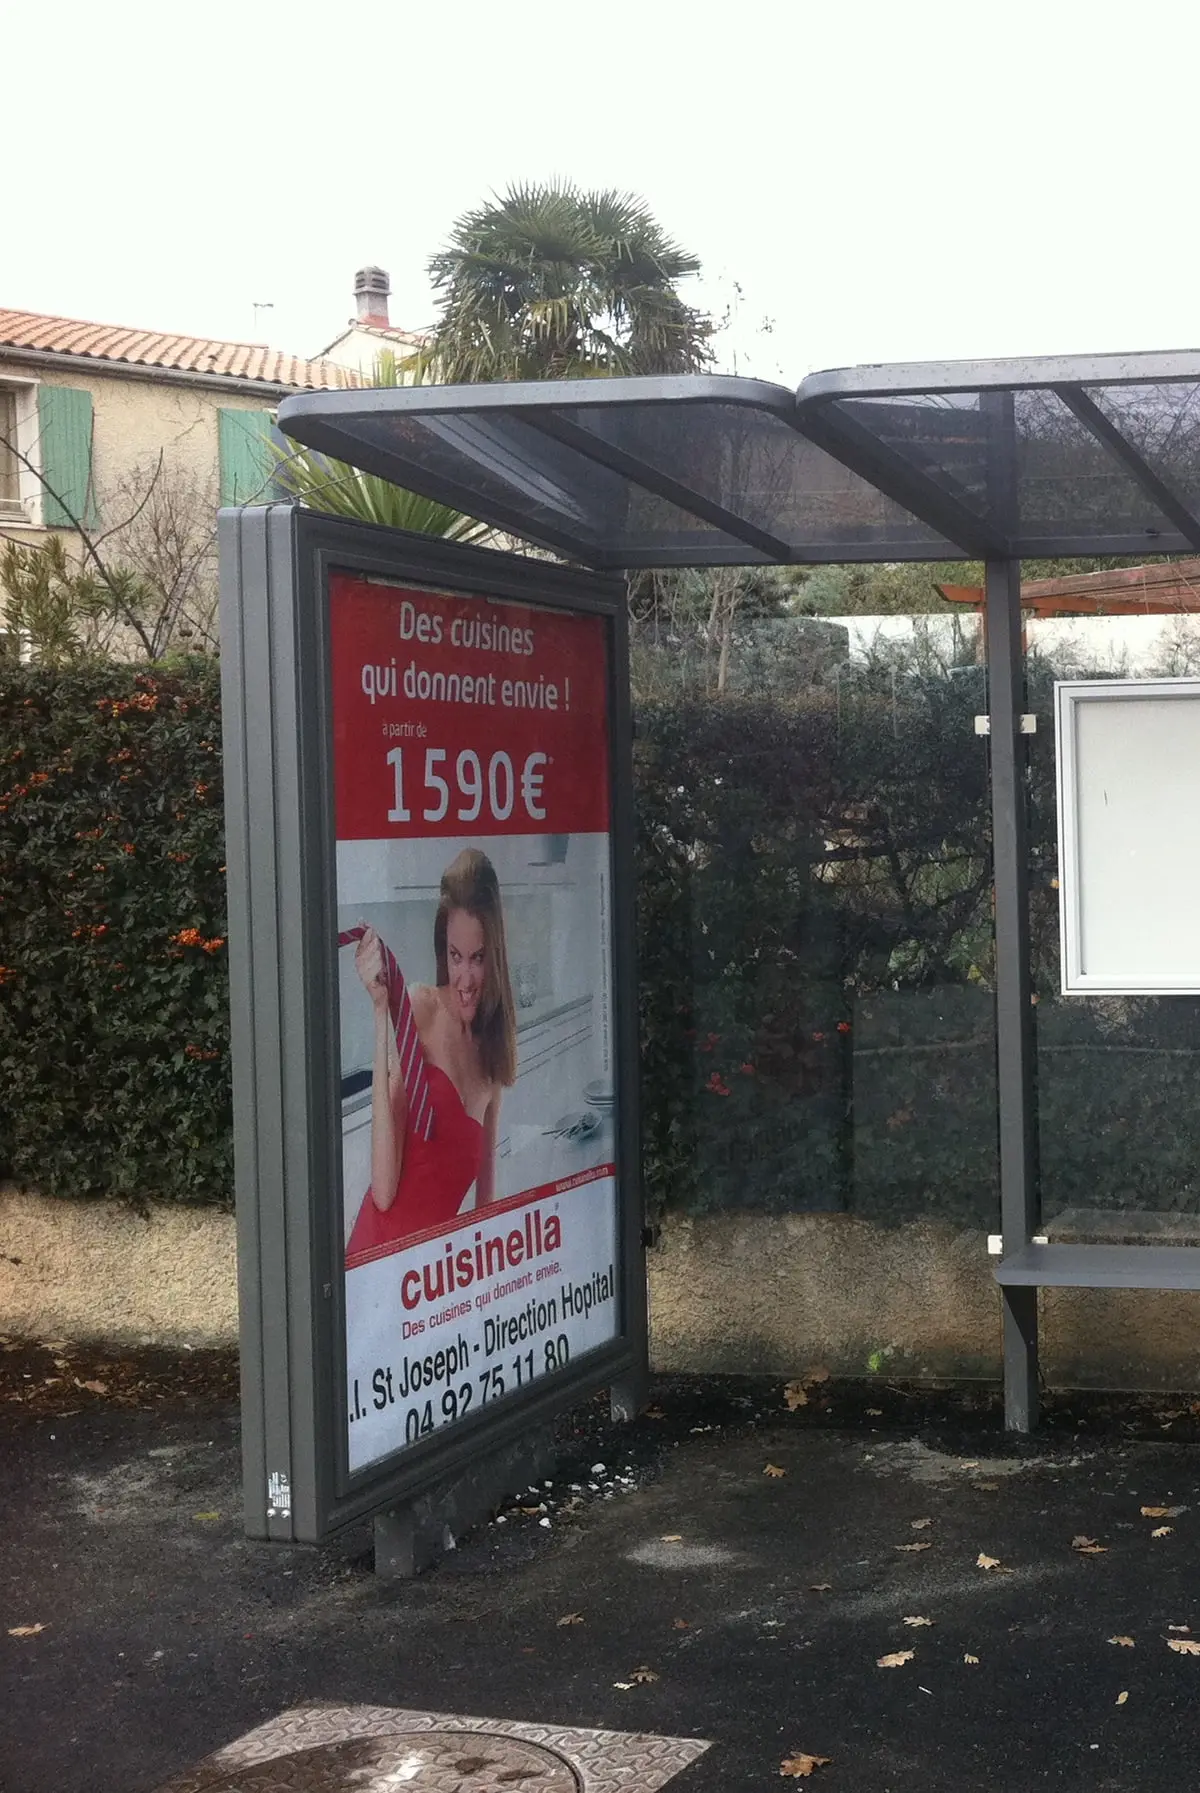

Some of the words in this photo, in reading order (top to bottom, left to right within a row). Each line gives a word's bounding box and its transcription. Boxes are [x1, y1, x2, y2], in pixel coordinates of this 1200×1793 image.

[400, 601, 443, 645] Des
[451, 613, 534, 656] cuisines
[361, 657, 397, 705] qui
[403, 660, 496, 706] donnent
[389, 720, 415, 740] partir
[416, 721, 428, 738] de
[401, 1209, 561, 1310] cuisinella
[372, 1367, 395, 1410] St
[399, 1333, 470, 1398] Joseph
[484, 1298, 557, 1357] Direction
[561, 1264, 614, 1319] Hopital
[402, 1318, 425, 1340] Des
[429, 1299, 472, 1329] cuisines
[475, 1292, 491, 1312] qui
[494, 1271, 533, 1300] donnent
[536, 1260, 562, 1282] envie.
[405, 1400, 434, 1445] 04
[441, 1382, 473, 1424] 92
[479, 1364, 505, 1404] 75
[512, 1349, 534, 1388] 11
[544, 1333, 570, 1373] 80
